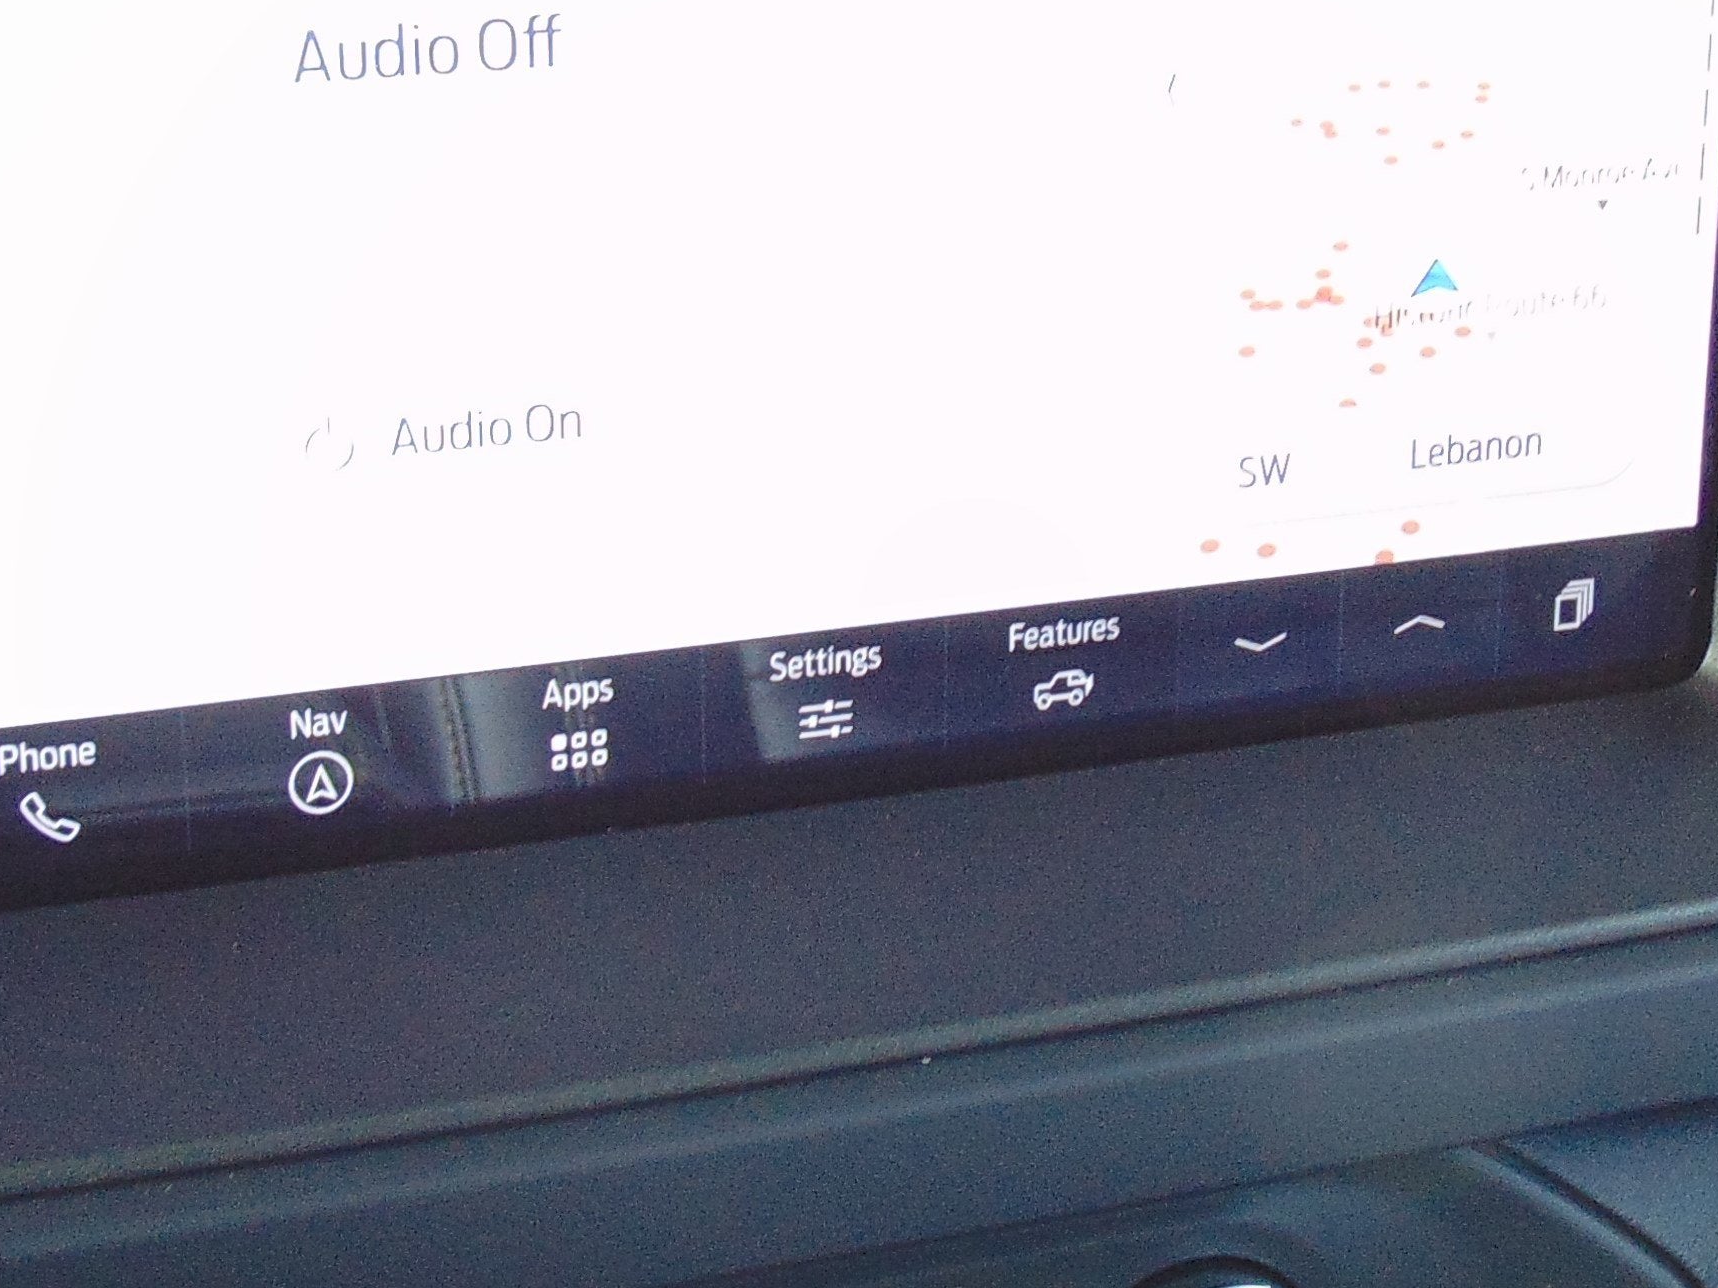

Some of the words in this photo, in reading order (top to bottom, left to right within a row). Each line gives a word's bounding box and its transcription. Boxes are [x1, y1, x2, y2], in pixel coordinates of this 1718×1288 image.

[294, 23, 460, 83] Audio
[477, 13, 562, 71] Off
[391, 410, 513, 456] Audio
[525, 403, 582, 442] On
[1410, 430, 1542, 470] Lebanon
[1238, 452, 1292, 490] SW
[1007, 613, 1122, 654] Features
[768, 641, 883, 683] Settings
[541, 675, 615, 711] Apps
[289, 708, 348, 739] Nav
